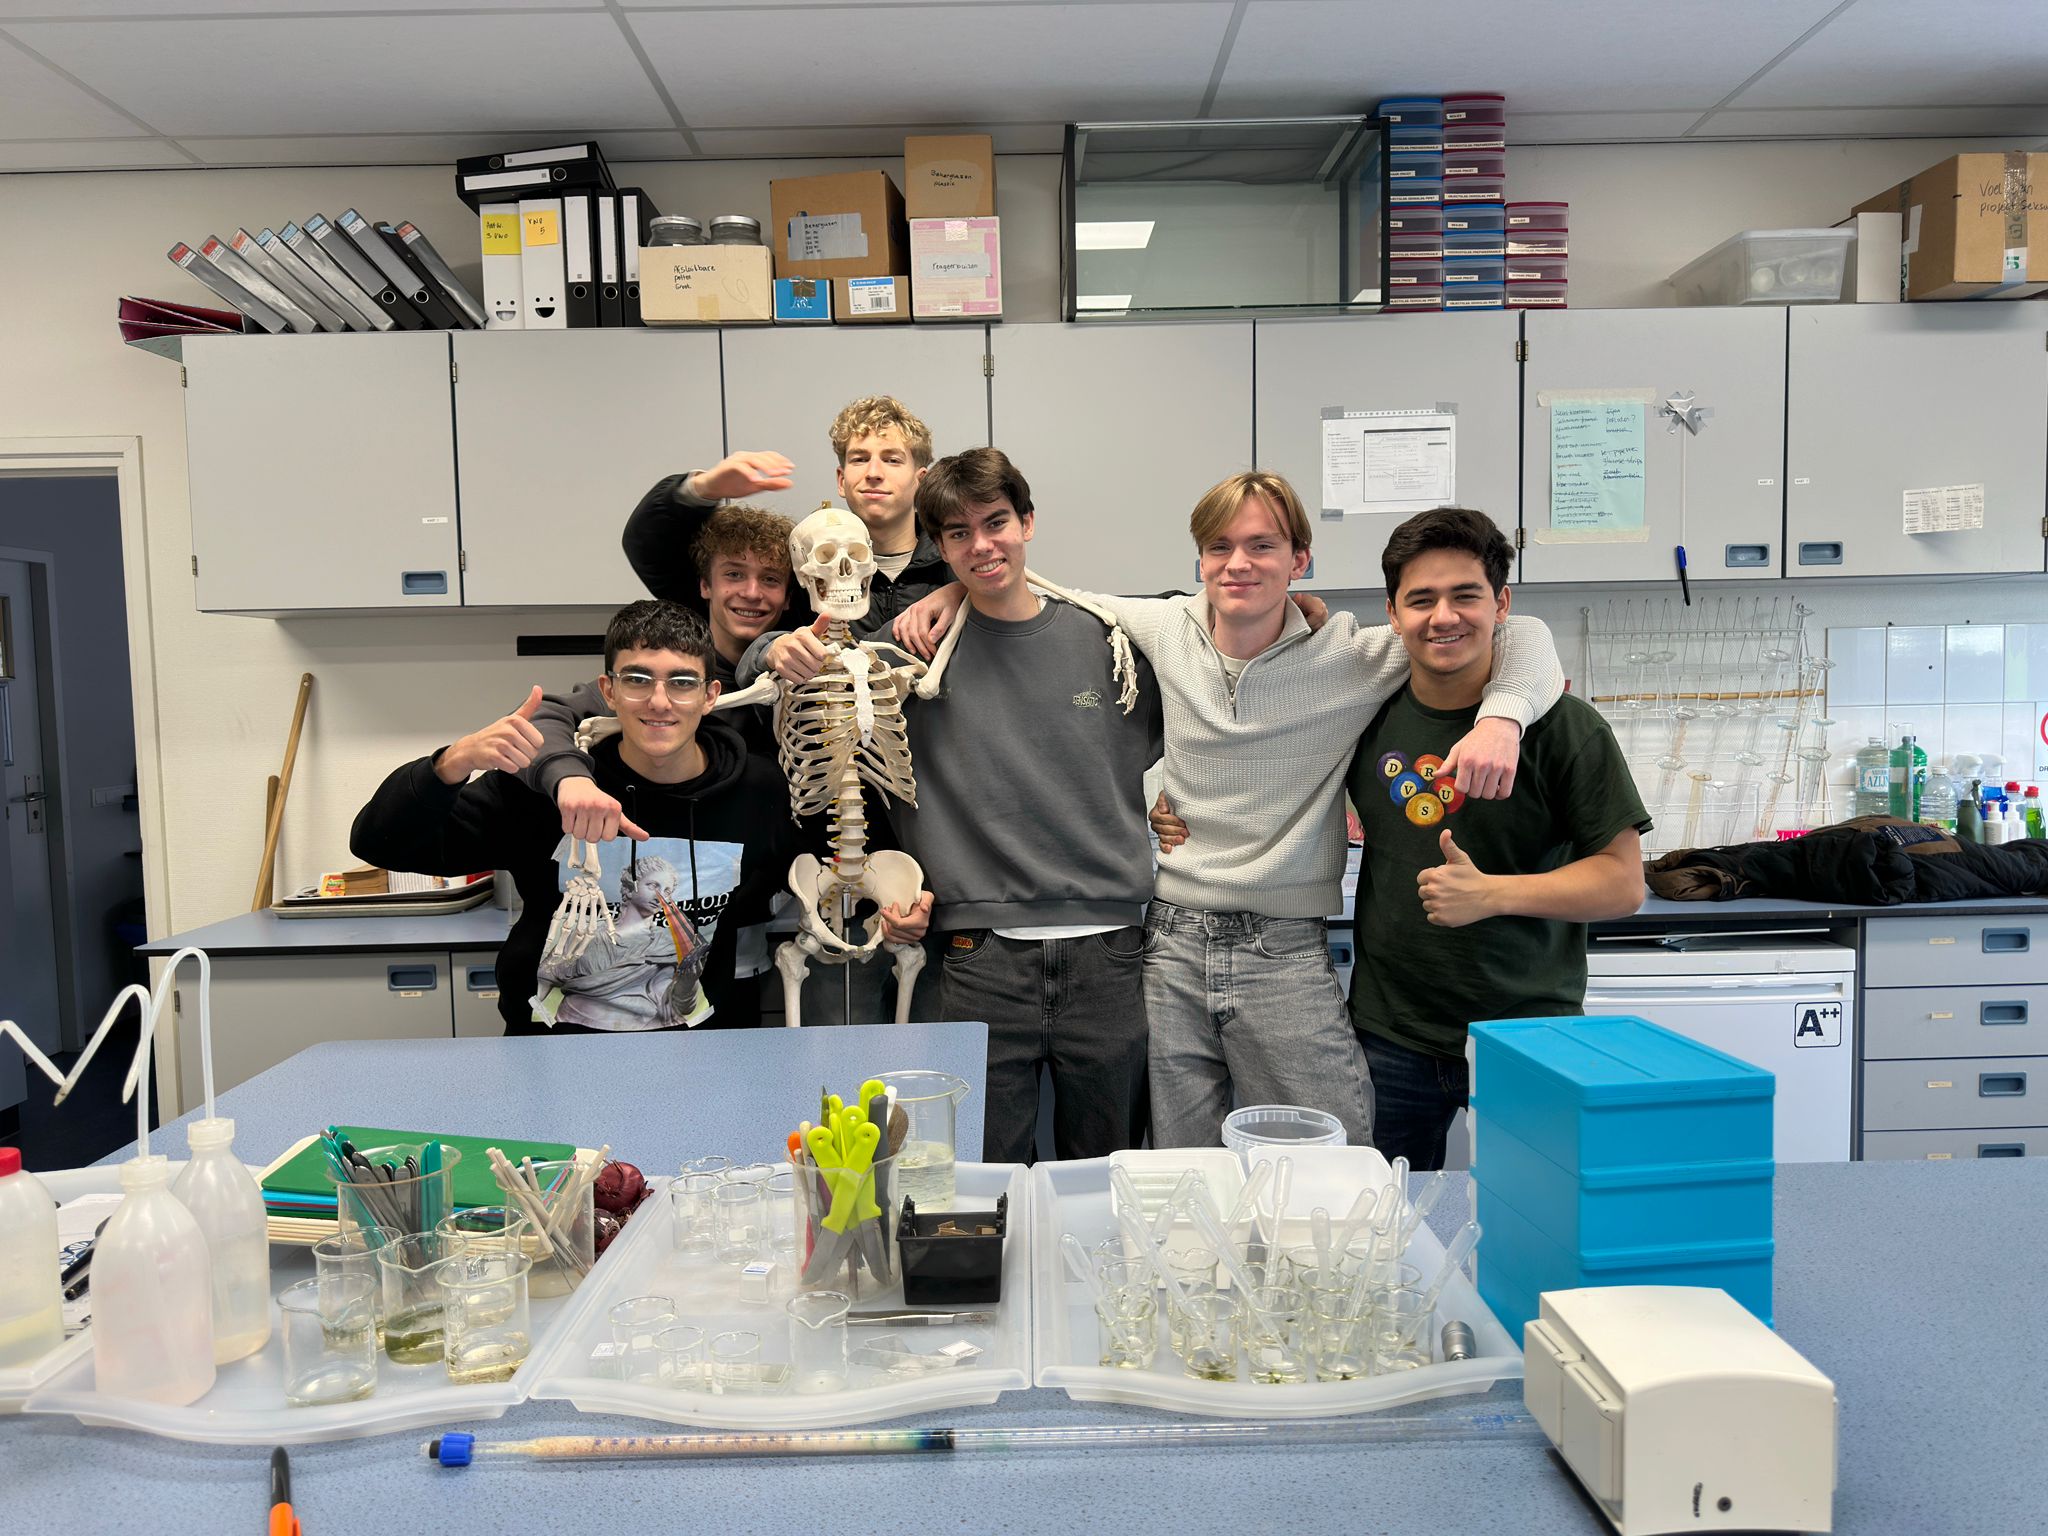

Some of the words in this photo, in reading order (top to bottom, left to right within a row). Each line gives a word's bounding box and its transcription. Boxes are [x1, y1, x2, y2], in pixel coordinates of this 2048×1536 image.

[1389, 763, 1398, 773] D
[1424, 767, 1434, 778] R
[1404, 785, 1413, 795] V
[1441, 790, 1451, 800] U
[1421, 806, 1429, 816] S
